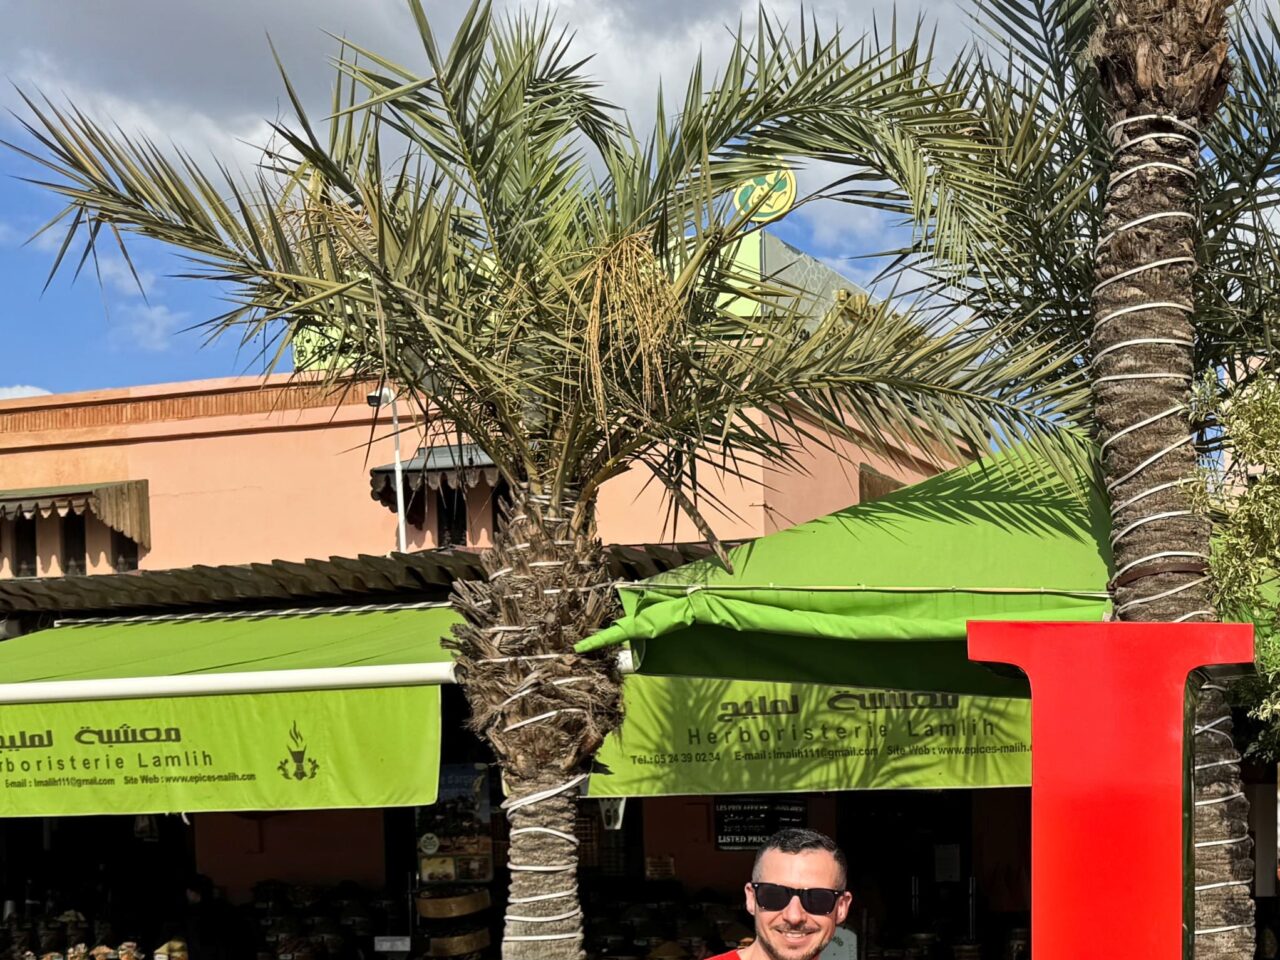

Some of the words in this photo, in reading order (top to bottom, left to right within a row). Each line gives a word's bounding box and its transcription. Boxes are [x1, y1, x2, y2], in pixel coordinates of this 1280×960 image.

[688, 721, 888, 745] Herboristerie
[908, 718, 995, 738] Lamlih
[138, 751, 213, 768] Lamlih
[717, 834, 747, 844] LISTED
